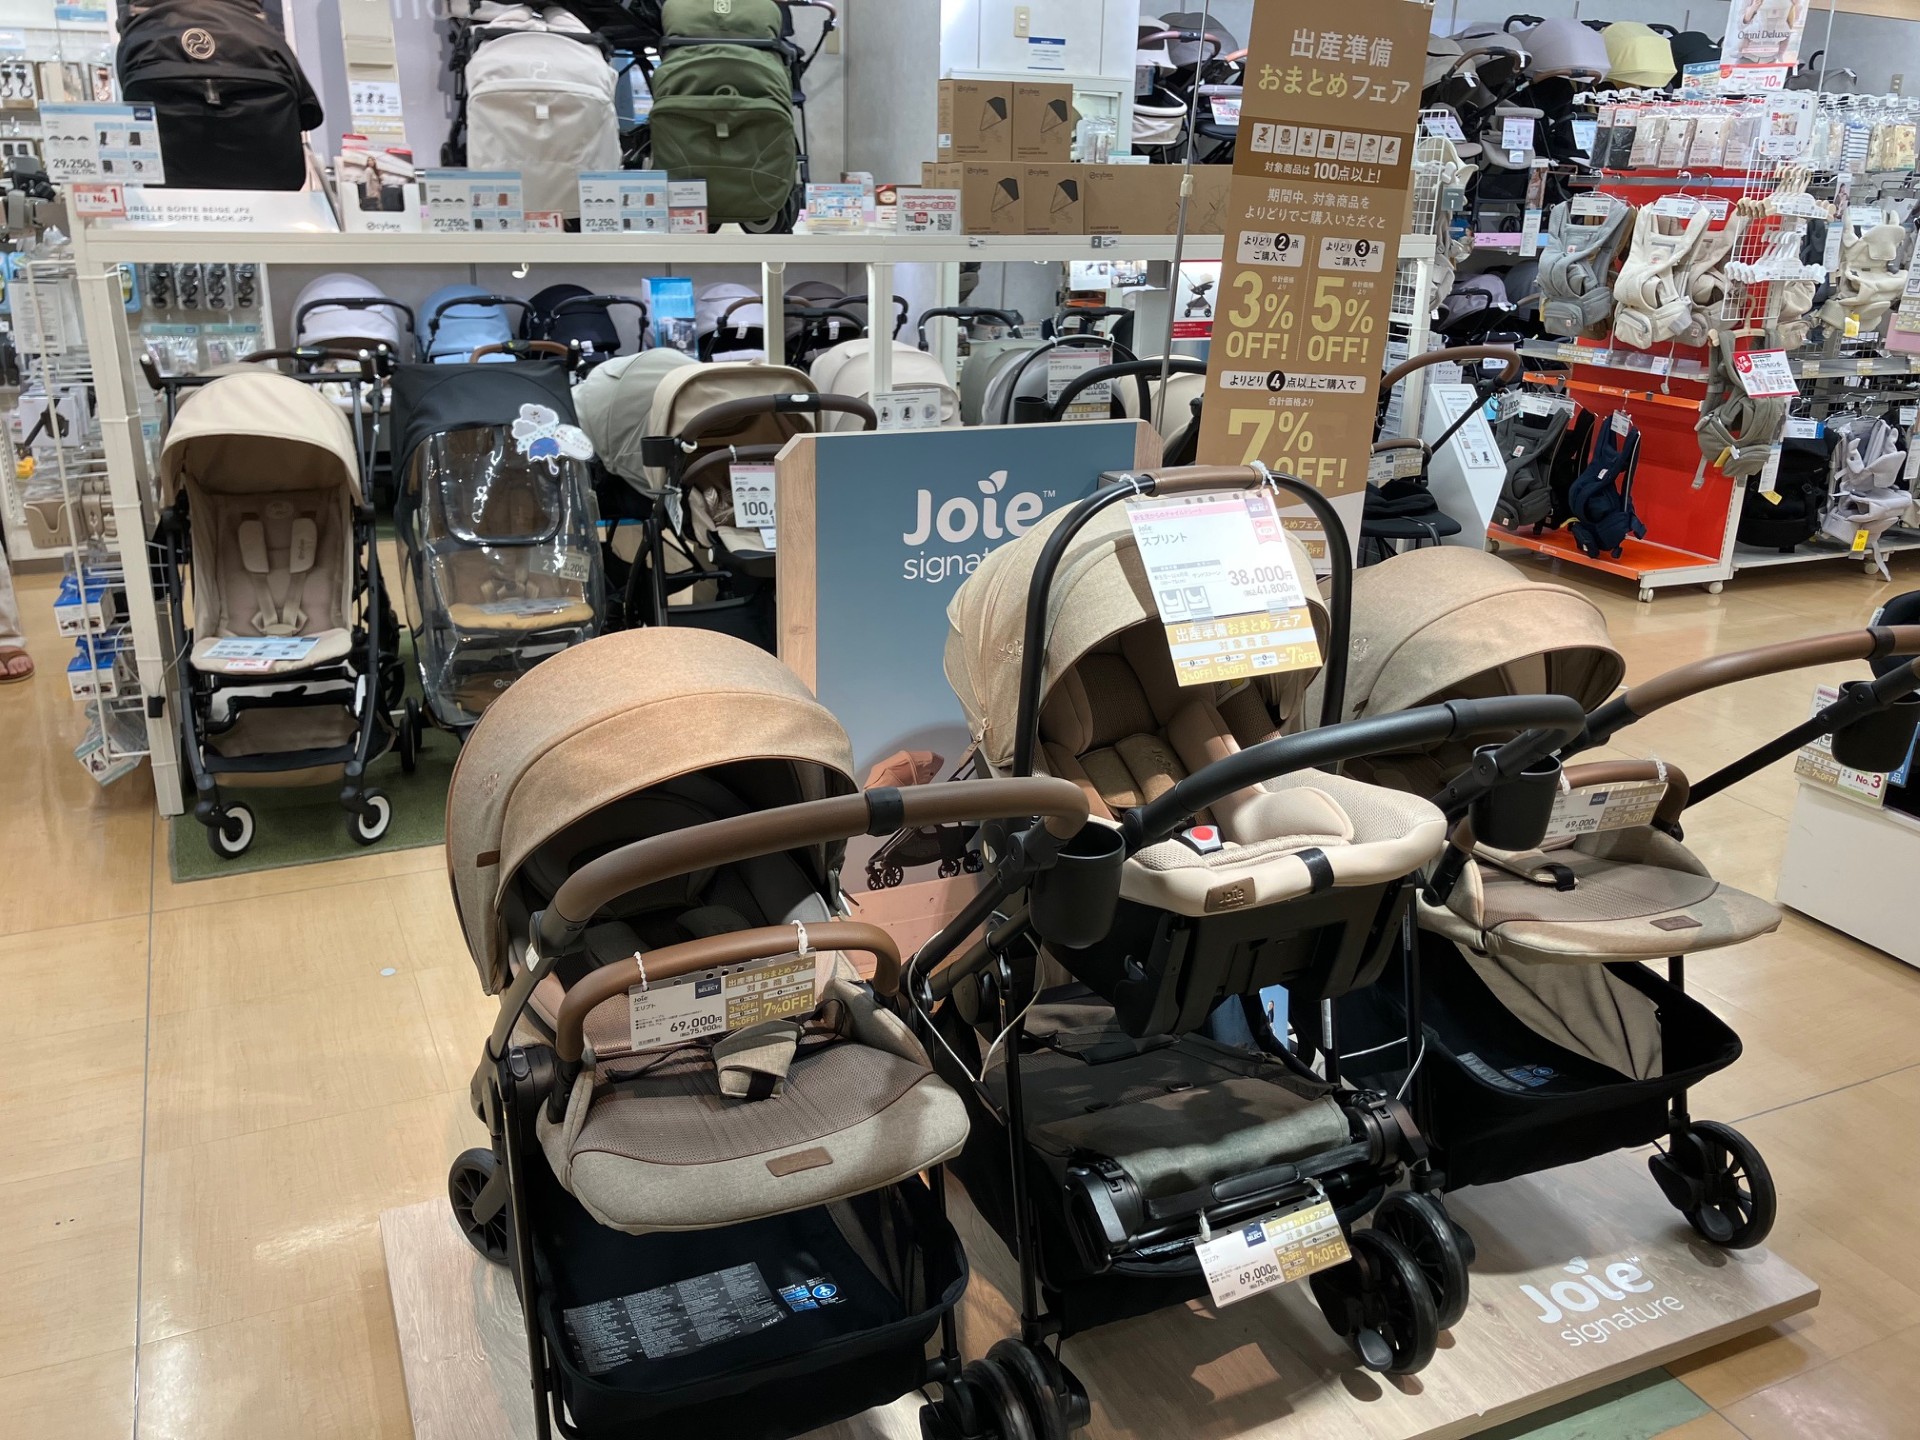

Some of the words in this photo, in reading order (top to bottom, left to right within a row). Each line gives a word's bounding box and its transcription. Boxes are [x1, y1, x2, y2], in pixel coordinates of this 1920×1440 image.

[1738, 30, 1760, 39] Omni
[1761, 30, 1790, 39] Deluxe
[1290, 28, 1394, 68] 出産準備
[1258, 63, 1411, 104] おまとめフェア
[1267, 188, 1370, 209] 期間中、対象商品を
[1245, 206, 1386, 229] よりどりでご購入いただくと
[1253, 250, 1287, 262] ご購入で
[1335, 256, 1367, 267] ご購入で
[1228, 271, 1294, 330] 3%
[1311, 275, 1374, 334] 5%
[1225, 331, 1290, 360] OFF!
[1307, 335, 1369, 363] OFF!
[903, 470, 1044, 546] Joie
[1142, 532, 1188, 547] スプリント
[1228, 565, 1293, 586] 38,000円
[763, 994, 813, 1016] 7%OFF!
[670, 1014, 723, 1032] 69,000円
[1519, 1256, 1654, 1323] Joie
[1560, 1296, 1685, 1347] signature
